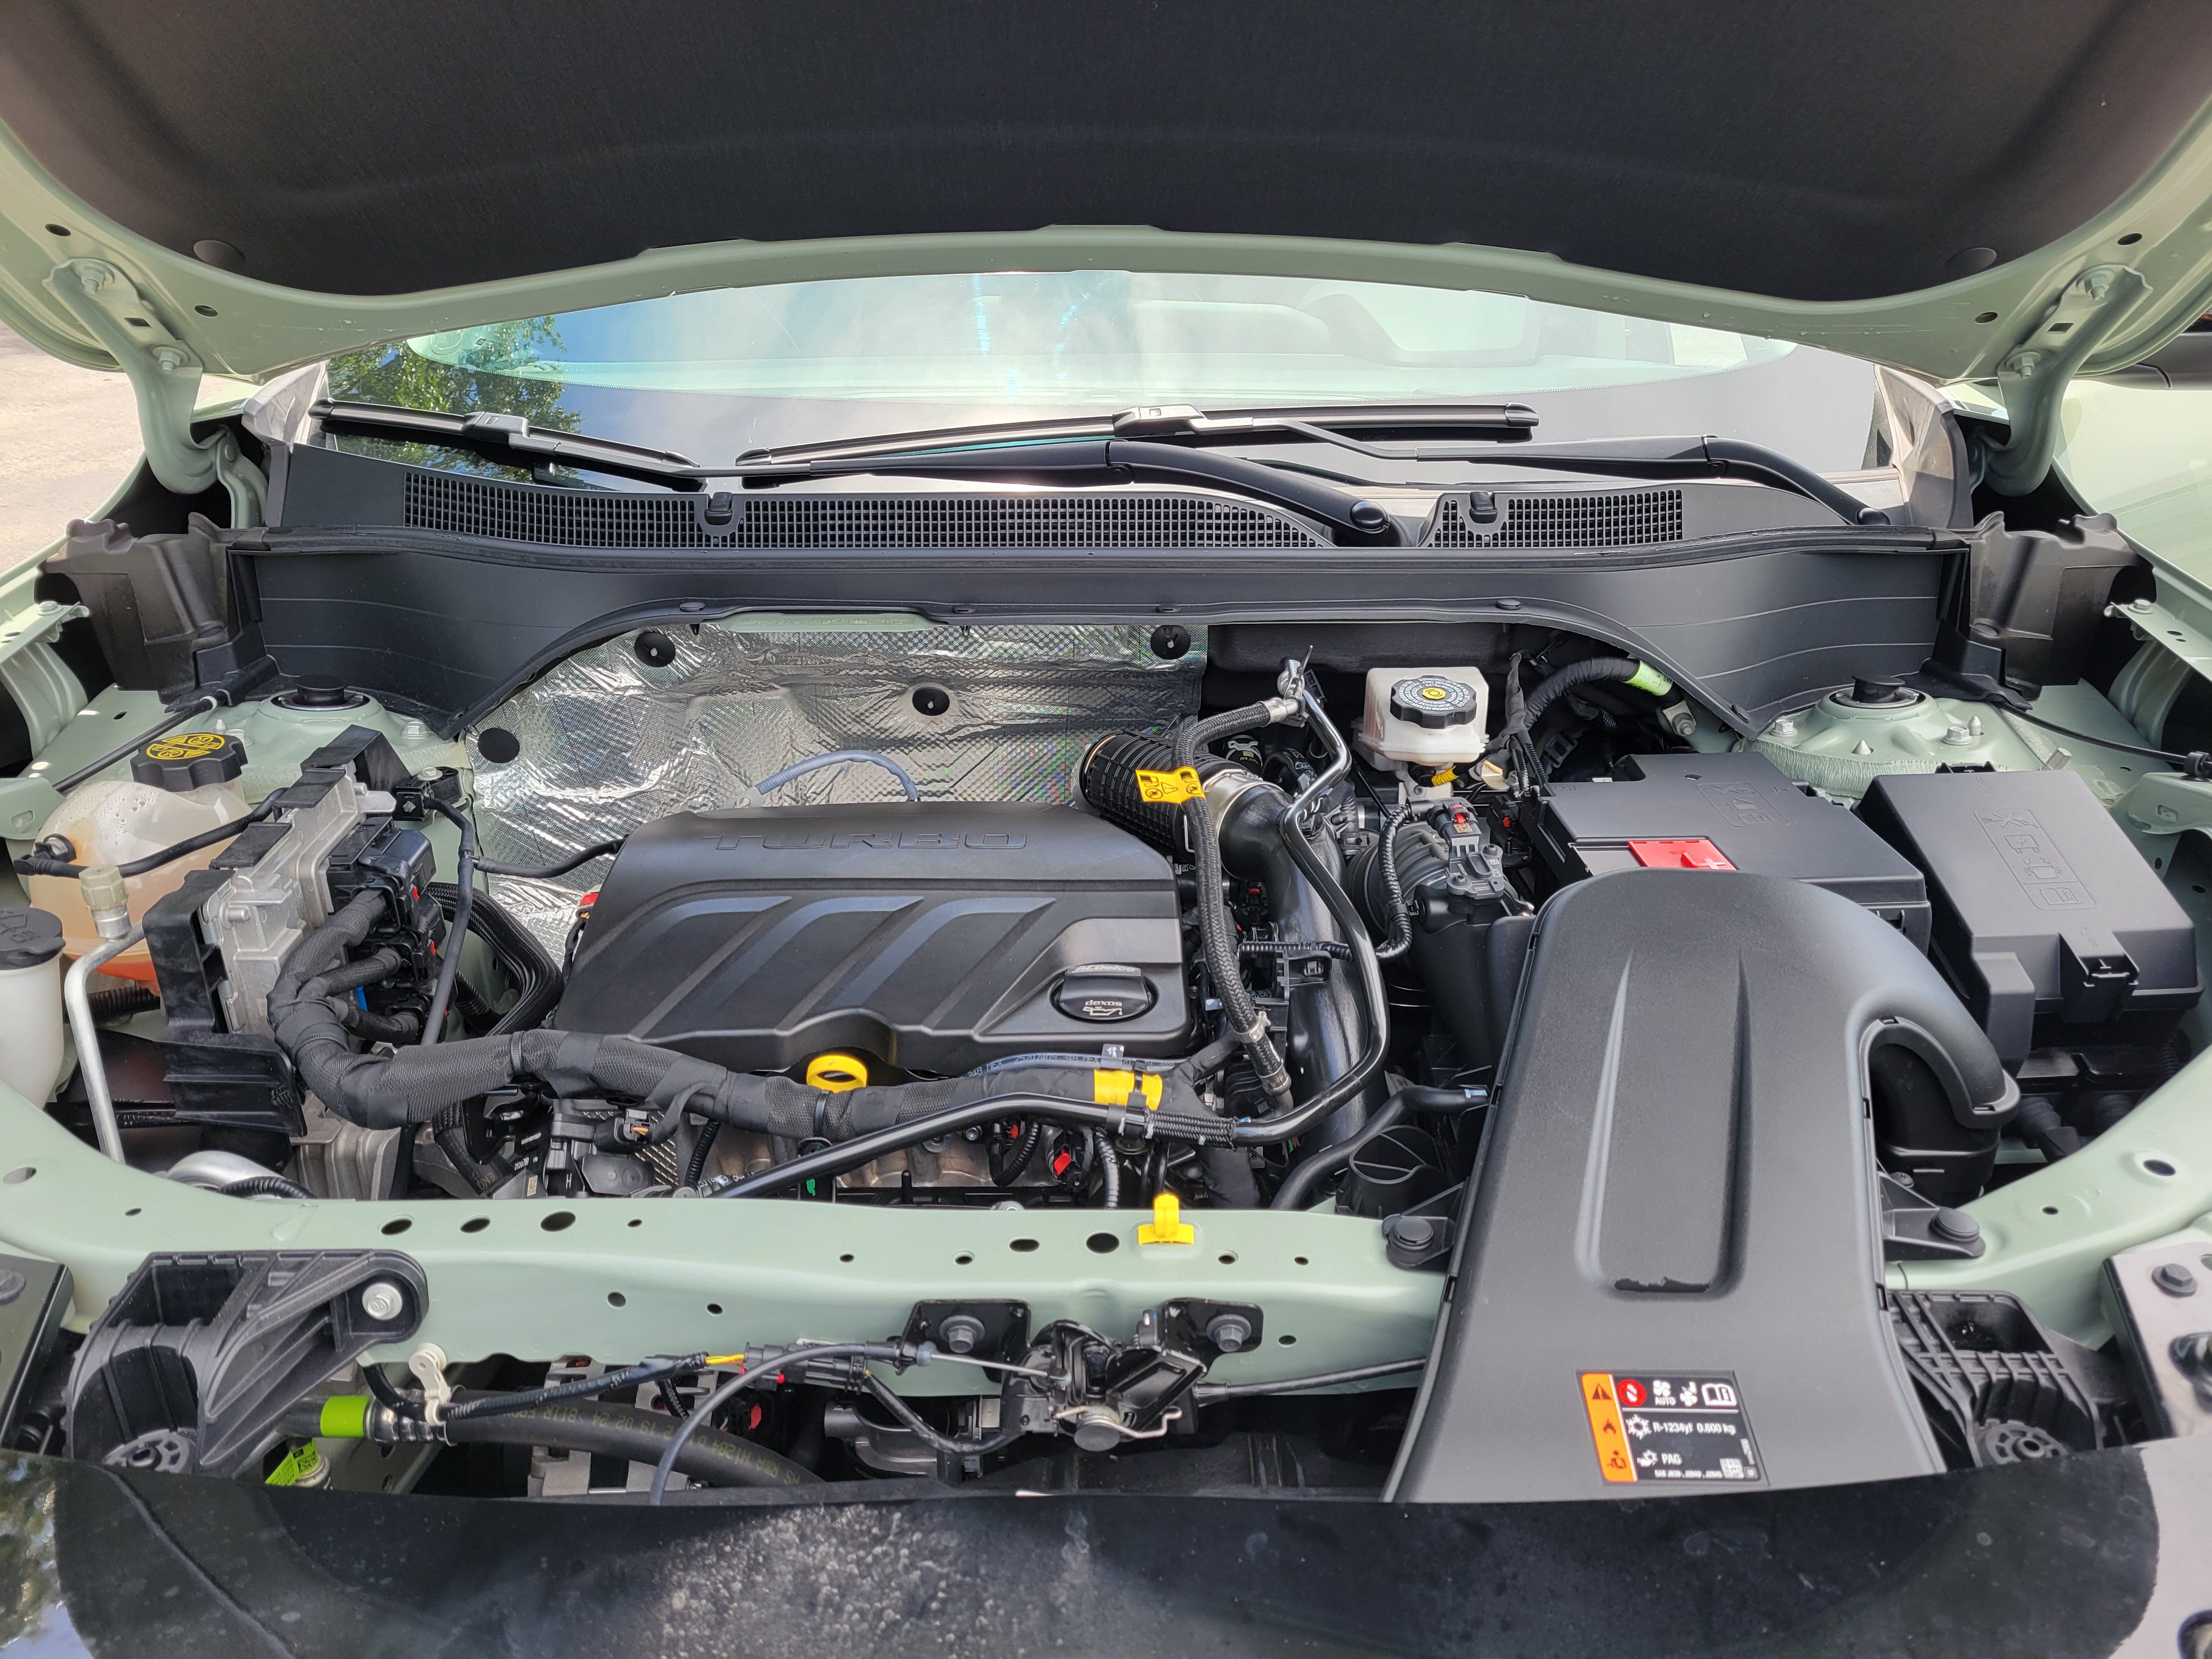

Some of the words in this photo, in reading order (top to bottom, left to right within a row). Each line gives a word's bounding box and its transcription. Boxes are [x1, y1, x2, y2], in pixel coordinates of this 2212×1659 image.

[701, 833, 1028, 851] TURBO
[1655, 1397, 1676, 1406] AUTO
[1722, 1423, 1736, 1436] kg
[1661, 1453, 1683, 1465] PAG
